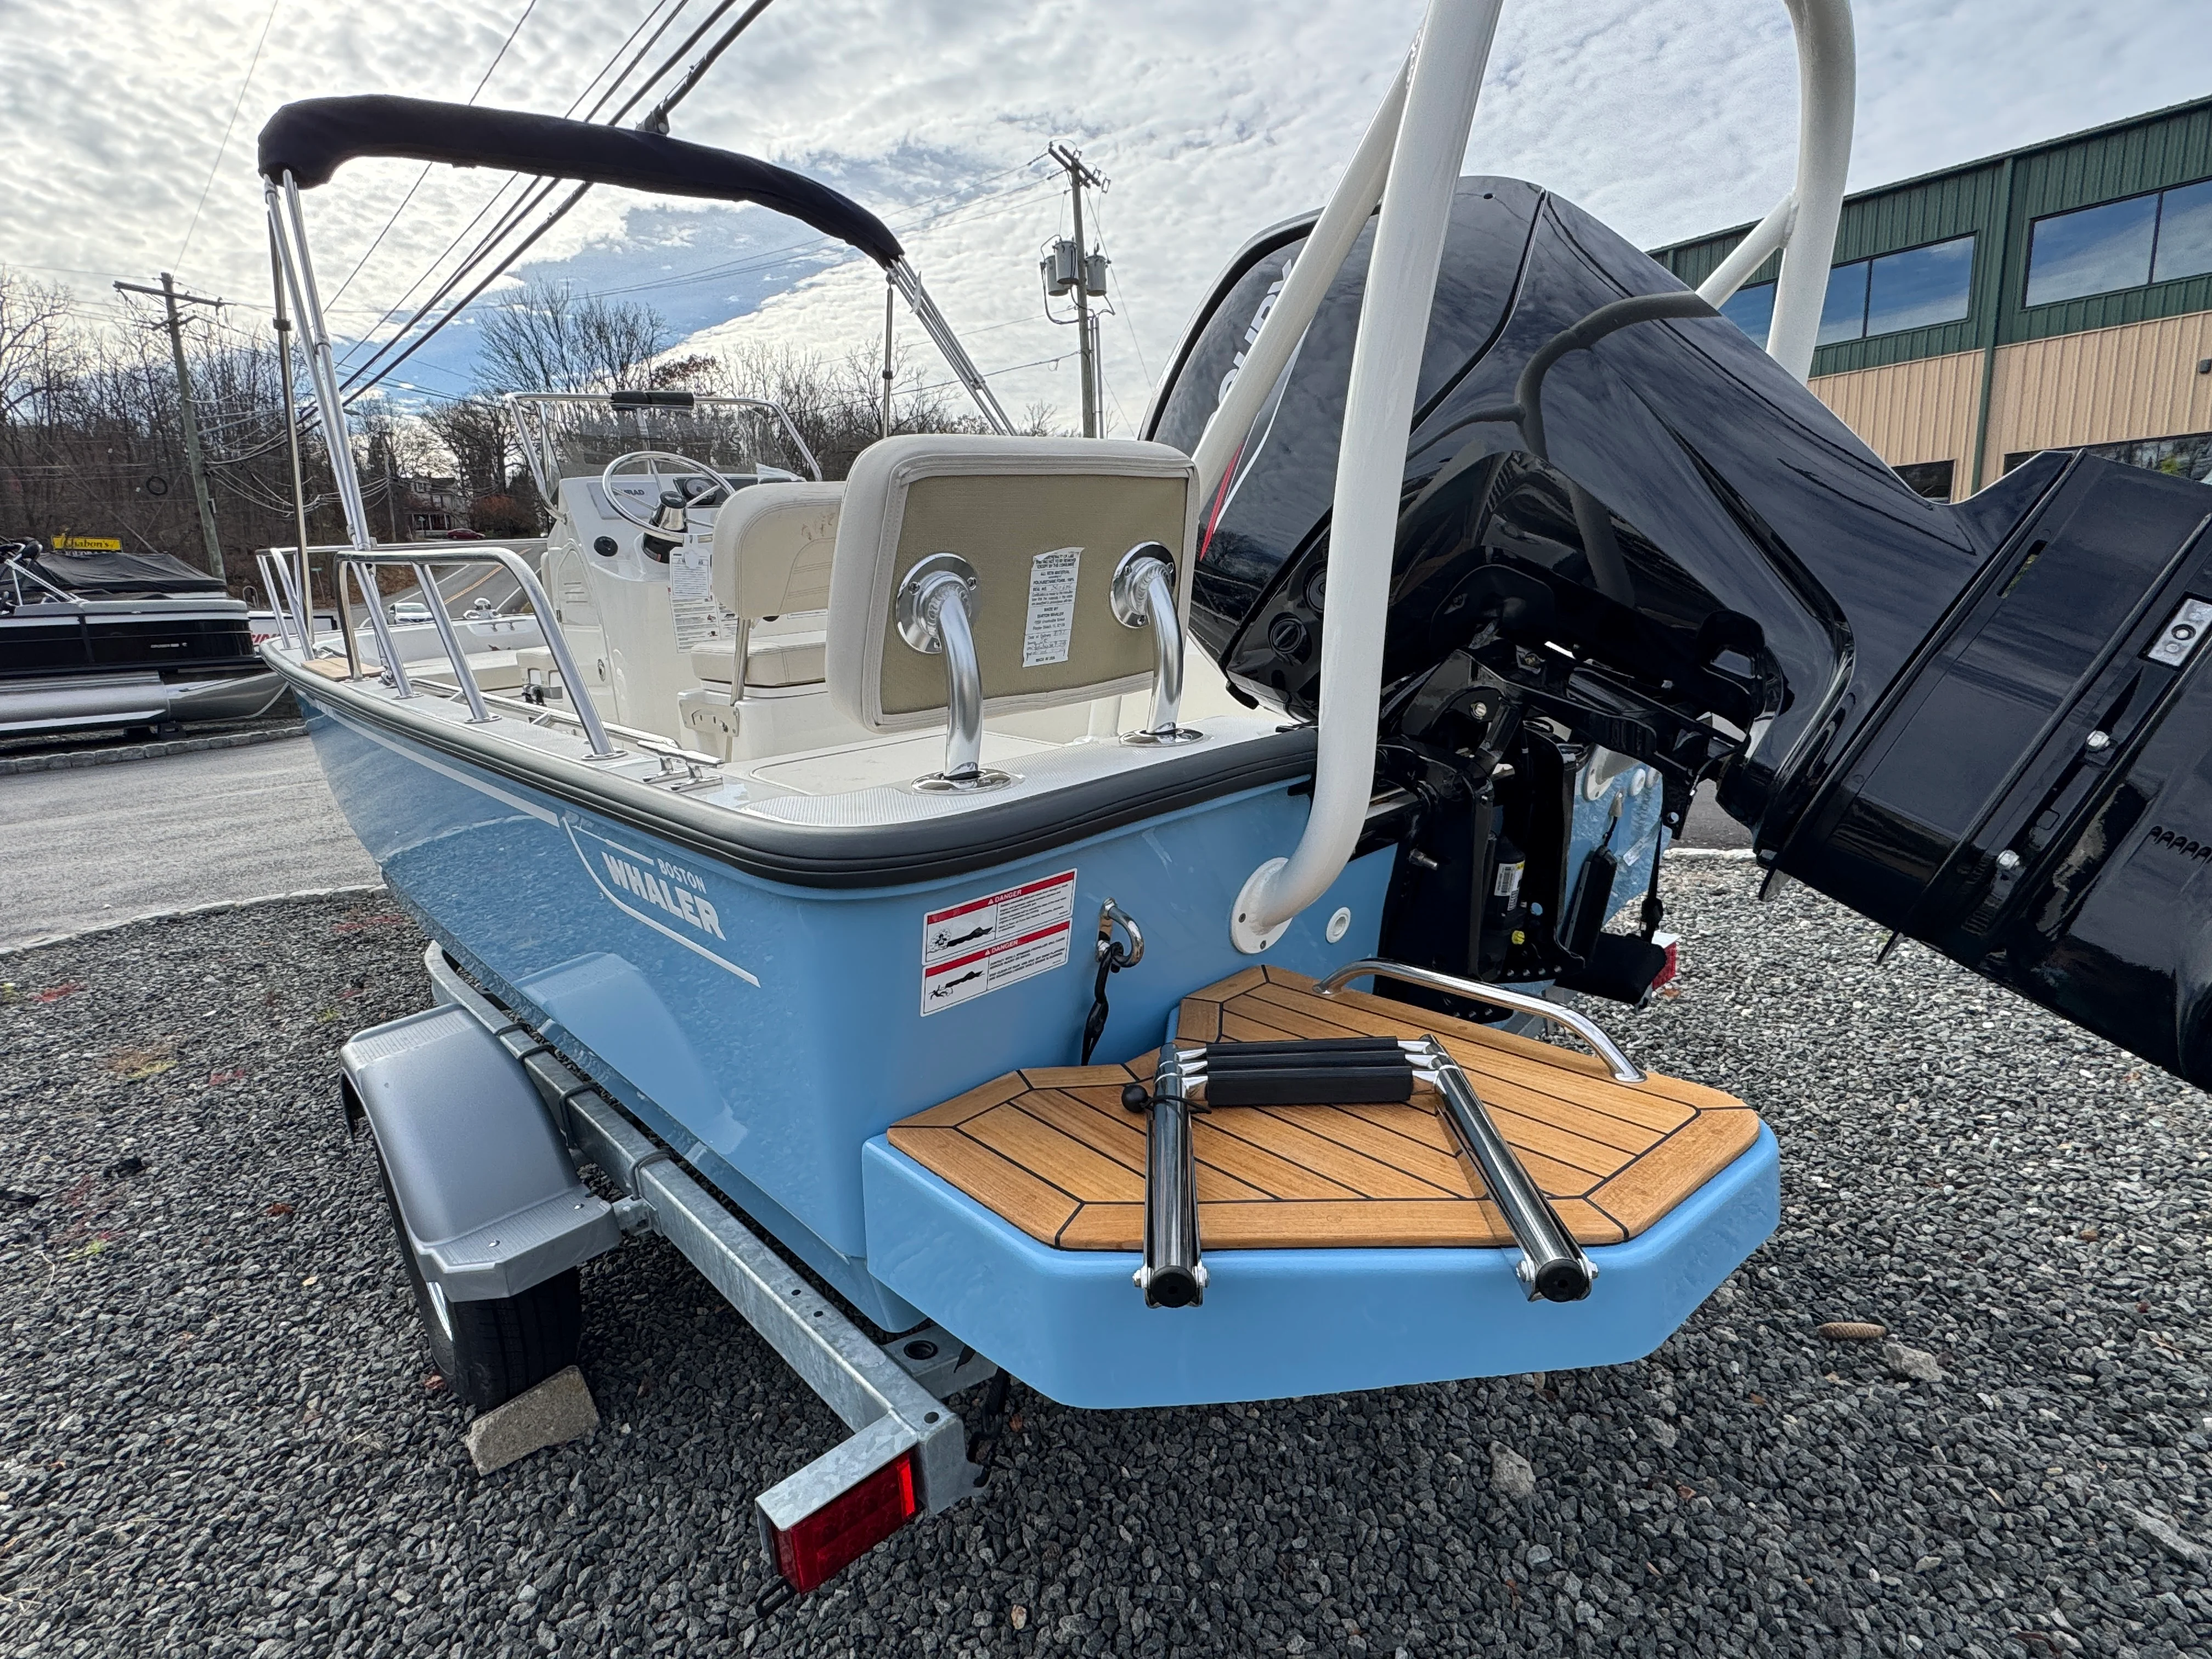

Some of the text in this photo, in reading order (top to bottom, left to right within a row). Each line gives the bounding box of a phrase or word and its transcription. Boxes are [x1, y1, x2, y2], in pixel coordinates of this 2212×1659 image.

[657, 858, 707, 894] BOSTON
[601, 851, 727, 941] WHALER
[994, 889, 1022, 902] DANGER
[991, 940, 1019, 953] DANGER
